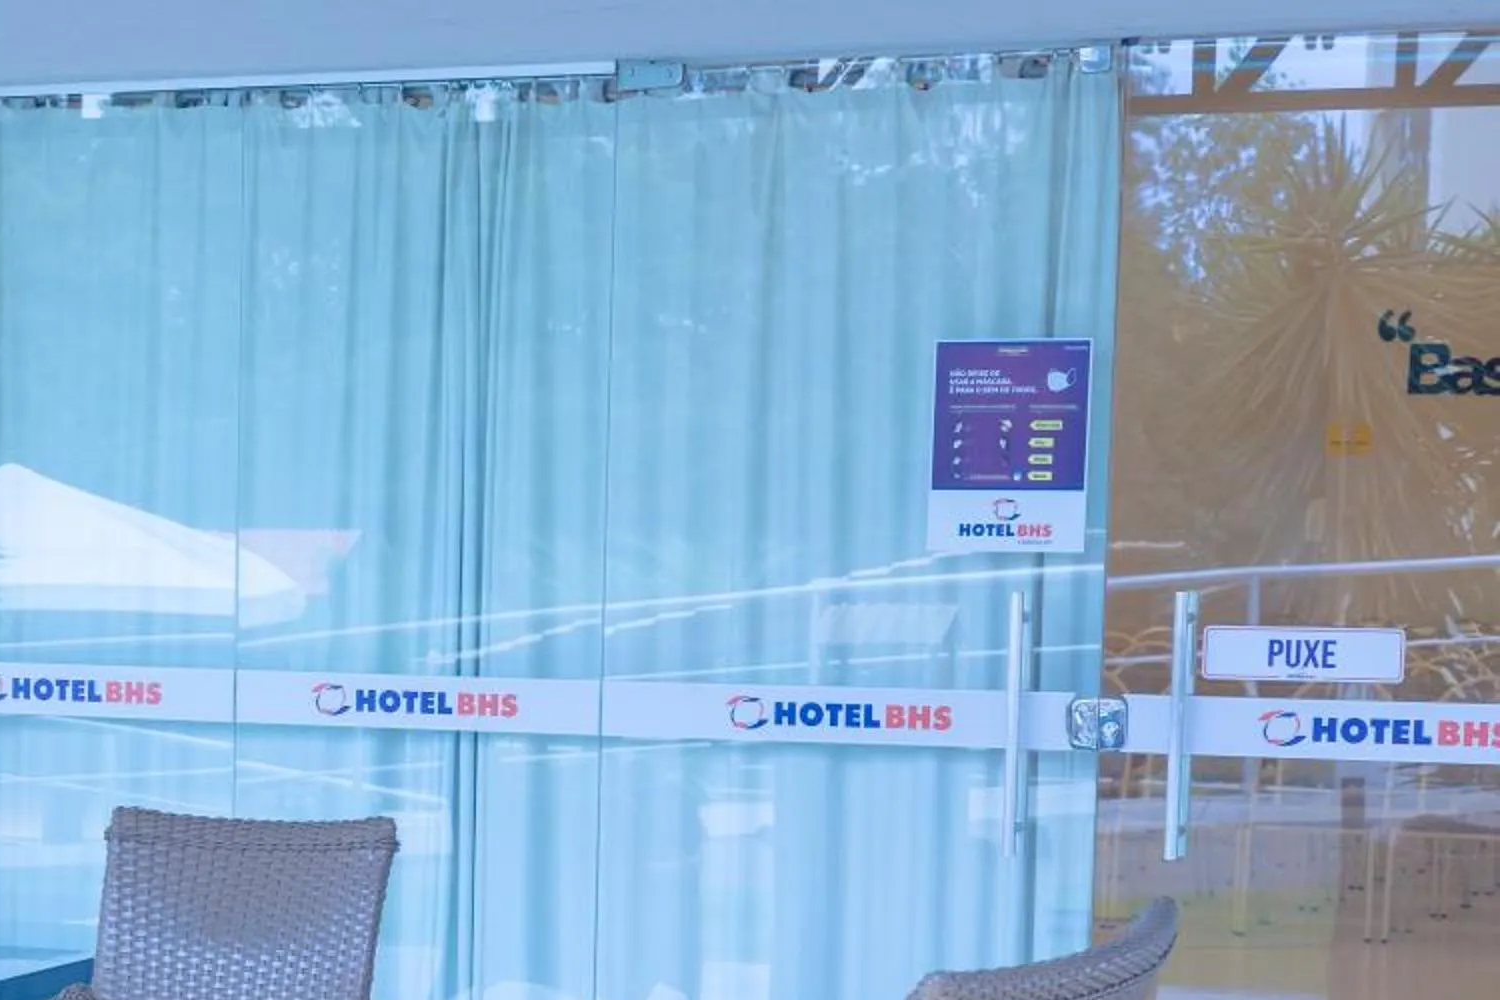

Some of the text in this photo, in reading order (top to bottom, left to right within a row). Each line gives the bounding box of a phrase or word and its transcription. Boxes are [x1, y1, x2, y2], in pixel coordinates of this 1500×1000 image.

[958, 523, 1053, 538] HOTEL BHS
[1267, 639, 1338, 669] PUXE
[11, 677, 163, 706] HOTEL BHS
[355, 689, 519, 718] HOTEL BHS
[773, 701, 953, 732] HOTEL BHS
[1311, 717, 1433, 746] HOTEL
